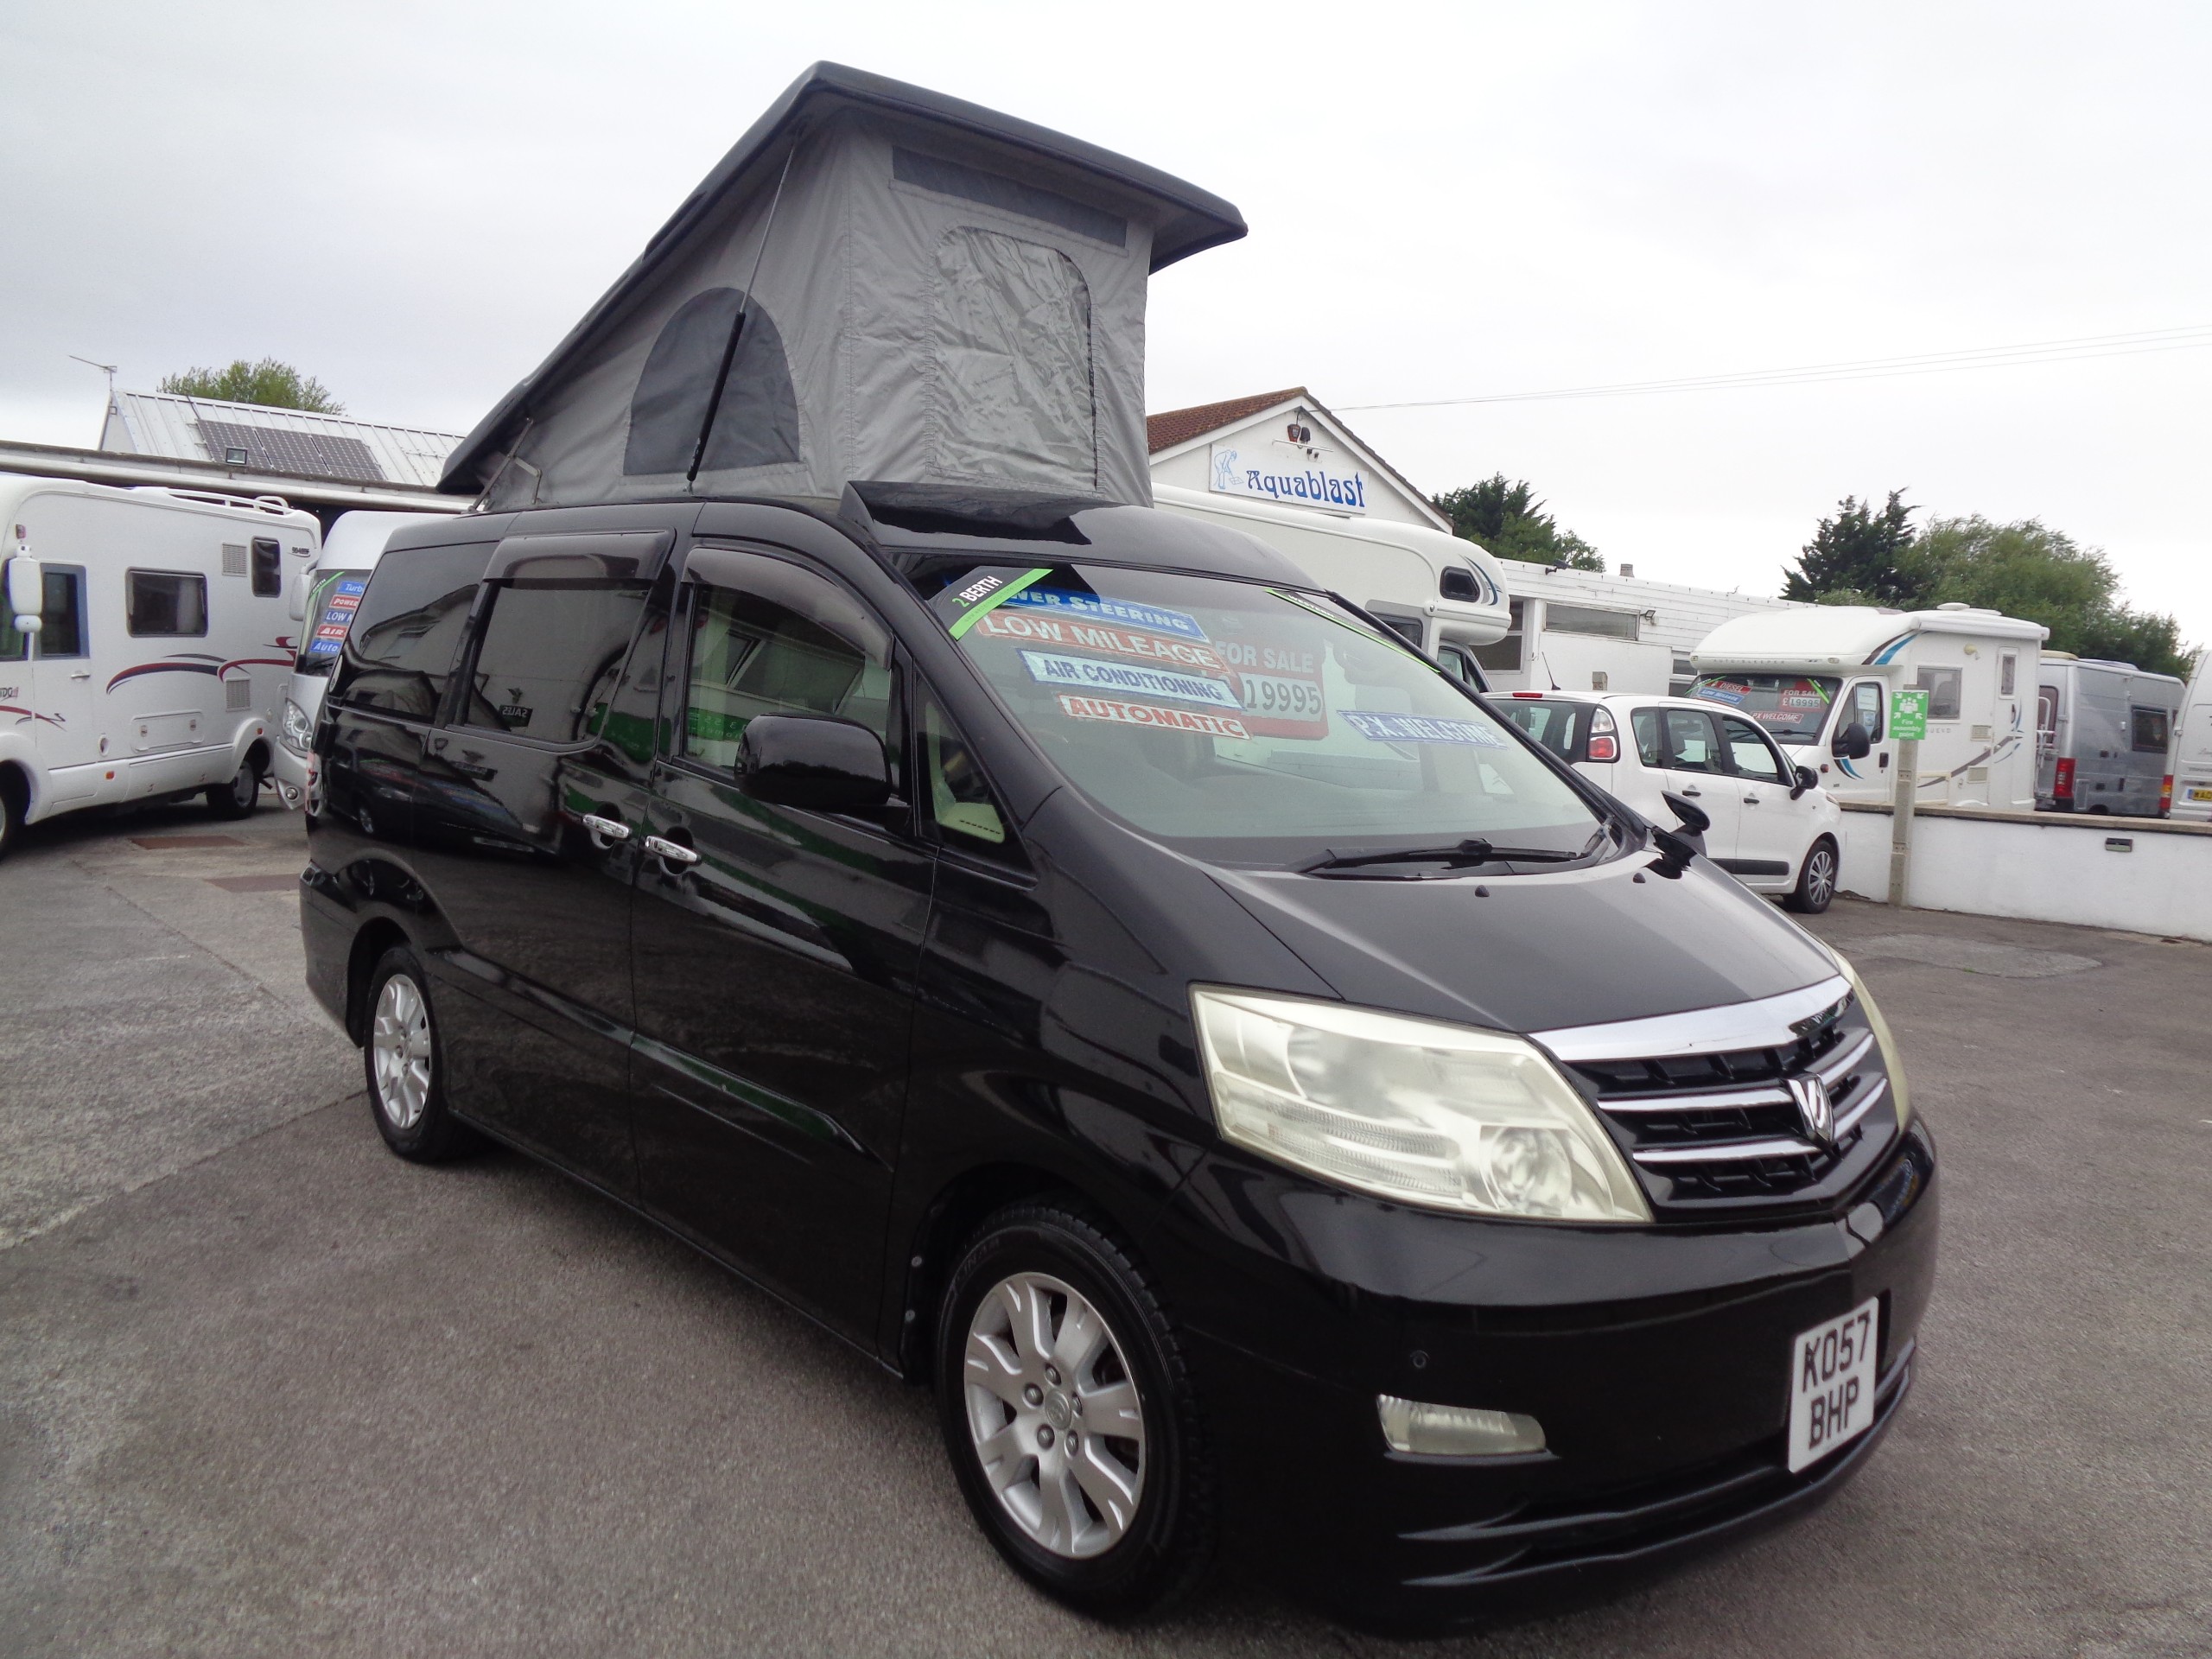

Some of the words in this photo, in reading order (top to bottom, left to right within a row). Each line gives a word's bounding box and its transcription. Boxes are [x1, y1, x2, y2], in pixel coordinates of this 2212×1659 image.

[1247, 470, 1364, 508] Aquablast
[952, 597, 969, 607] 2
[959, 575, 1003, 601] BERTH
[327, 612, 346, 621] LOW
[1010, 590, 1062, 606] WER
[1069, 596, 1190, 631] STEERING
[982, 614, 1063, 641] LOW
[1070, 625, 1221, 669] MILEAGE
[1215, 641, 1257, 666] FOR
[1263, 648, 1314, 673] SALE
[1043, 659, 1080, 680] AIR
[1082, 664, 1224, 701] CONDITIONING
[1246, 679, 1322, 715] 19995
[1069, 698, 1245, 737] AUTOMATIC
[1763, 713, 1798, 721] WELCOME
[1802, 1310, 1870, 1394] KO57
[1808, 1376, 1860, 1450] BHP
